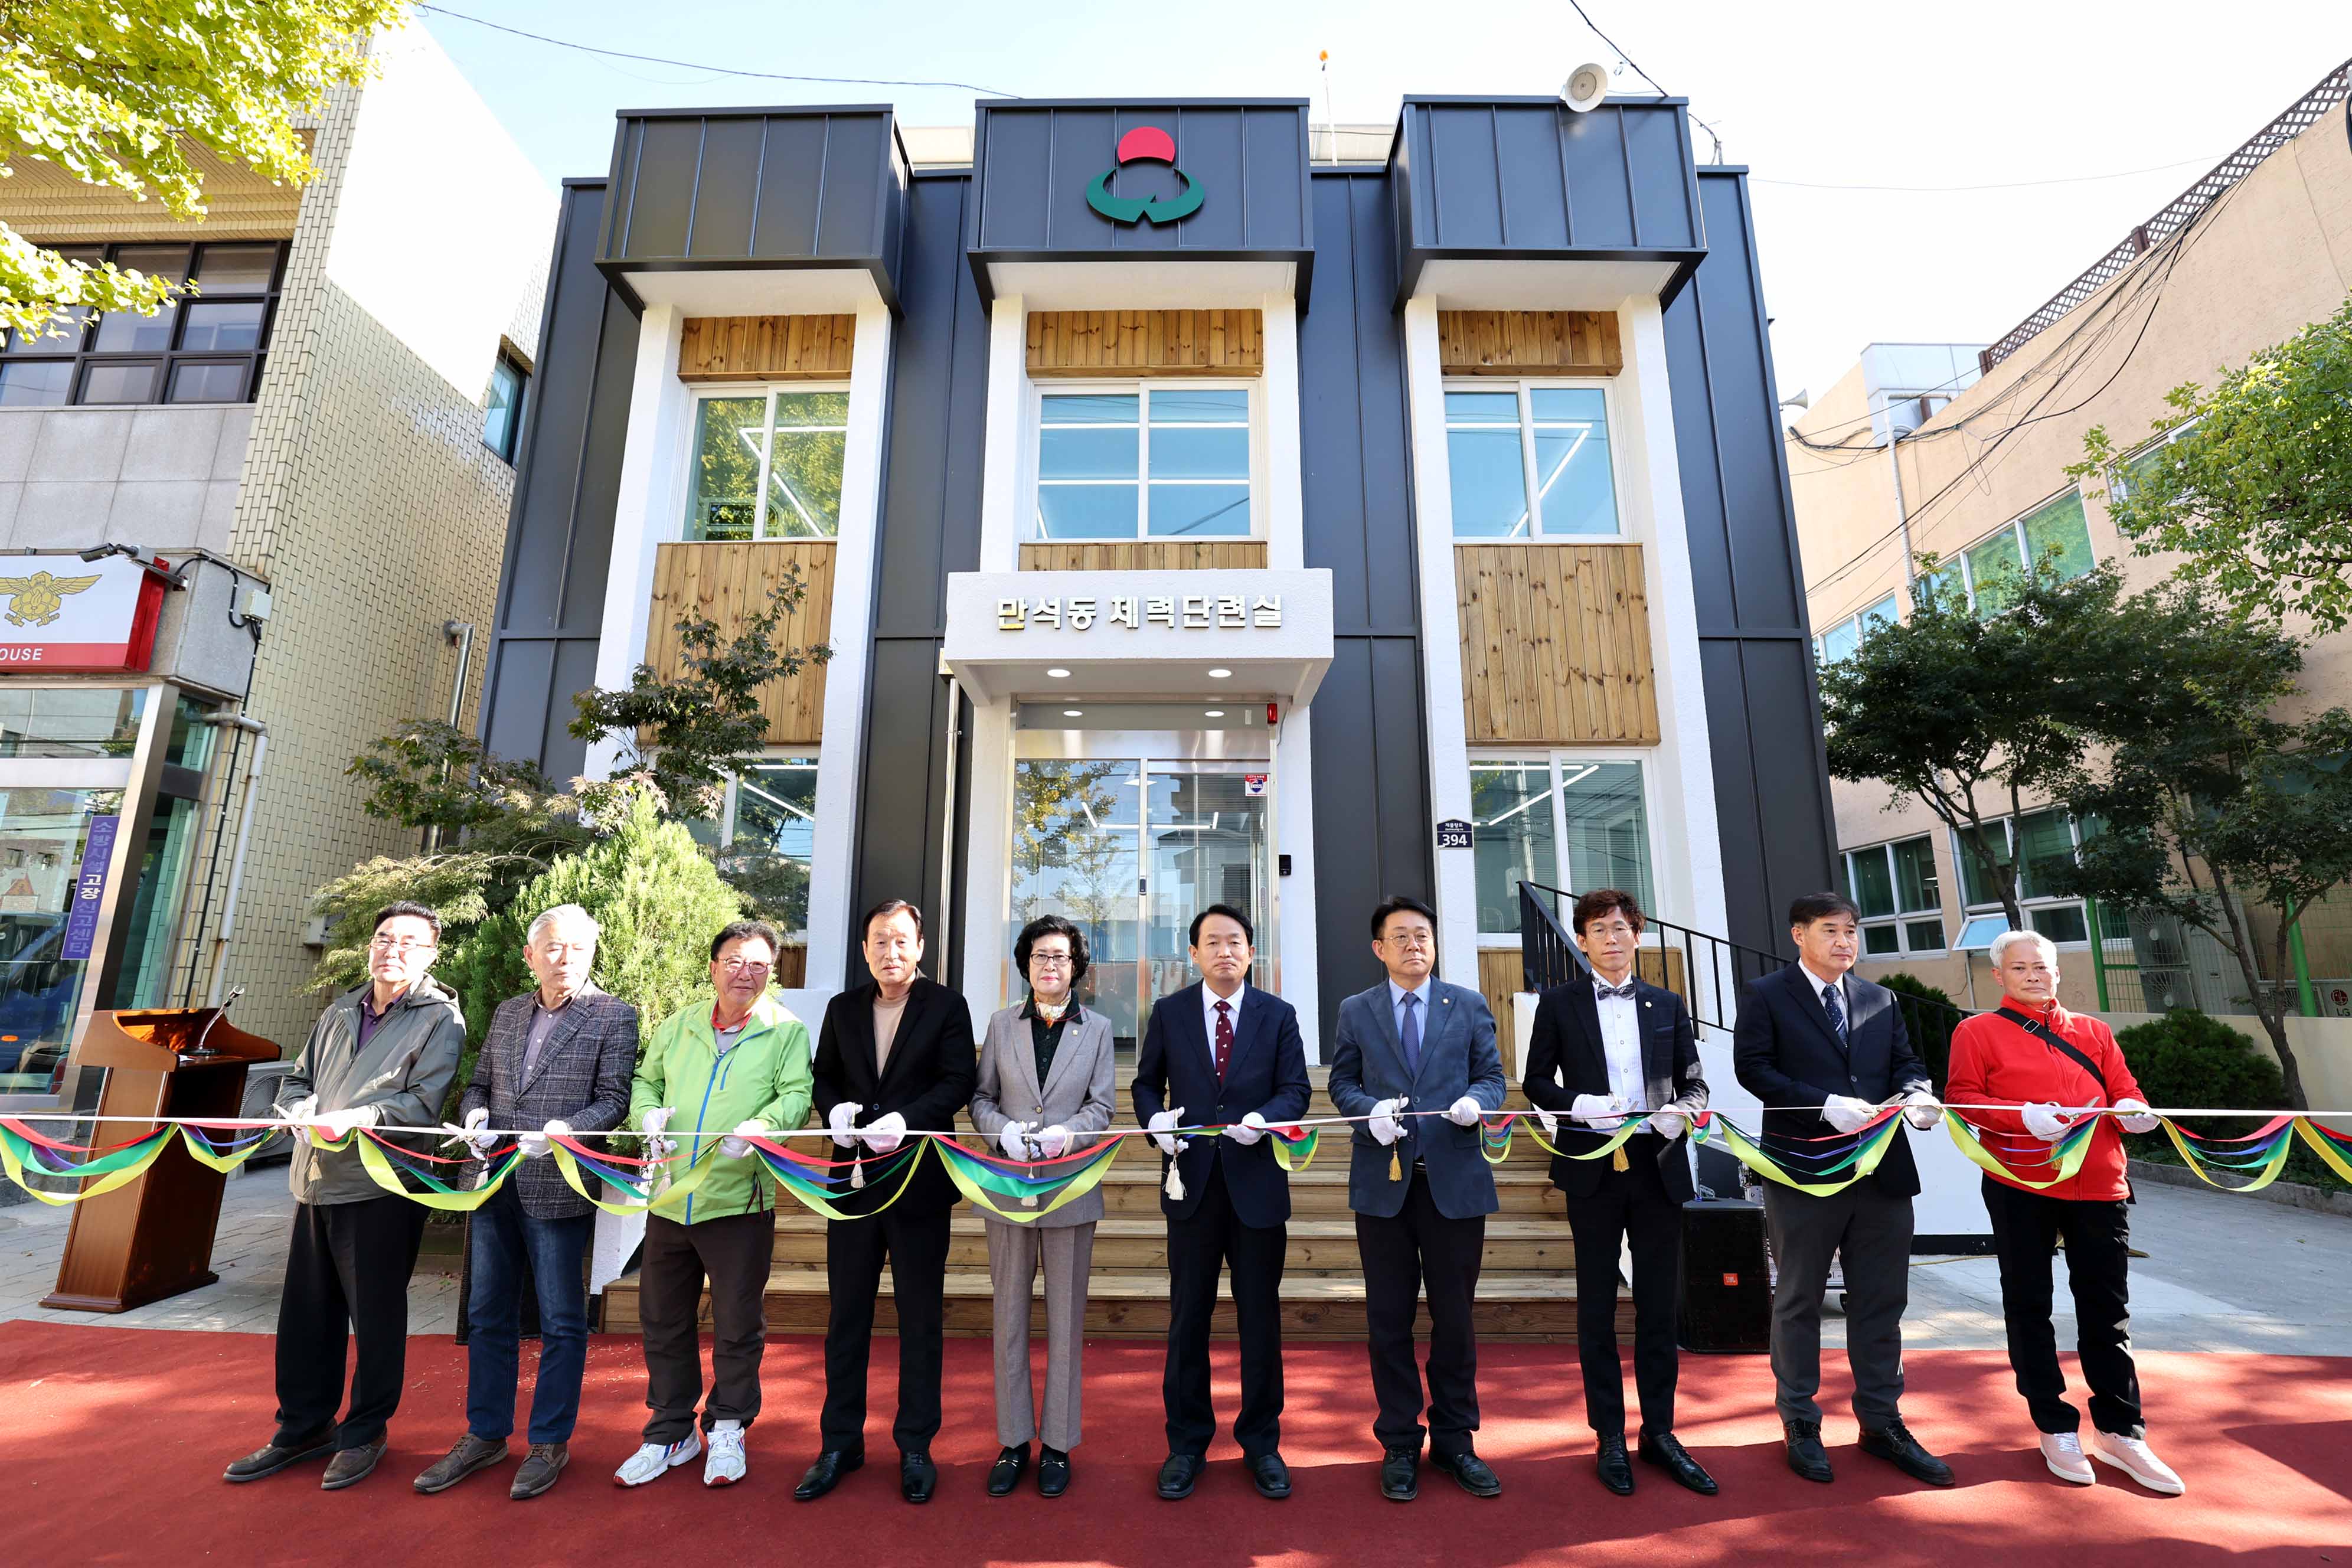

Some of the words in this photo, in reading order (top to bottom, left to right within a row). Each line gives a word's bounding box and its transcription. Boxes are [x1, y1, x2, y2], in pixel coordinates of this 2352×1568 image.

[998, 596, 1096, 631] 만석동
[1110, 595, 1282, 629] 체력단련실
[1442, 834, 1468, 846] 394
[80, 874, 102, 900] 고장
[2337, 1008, 2350, 1017] LG
